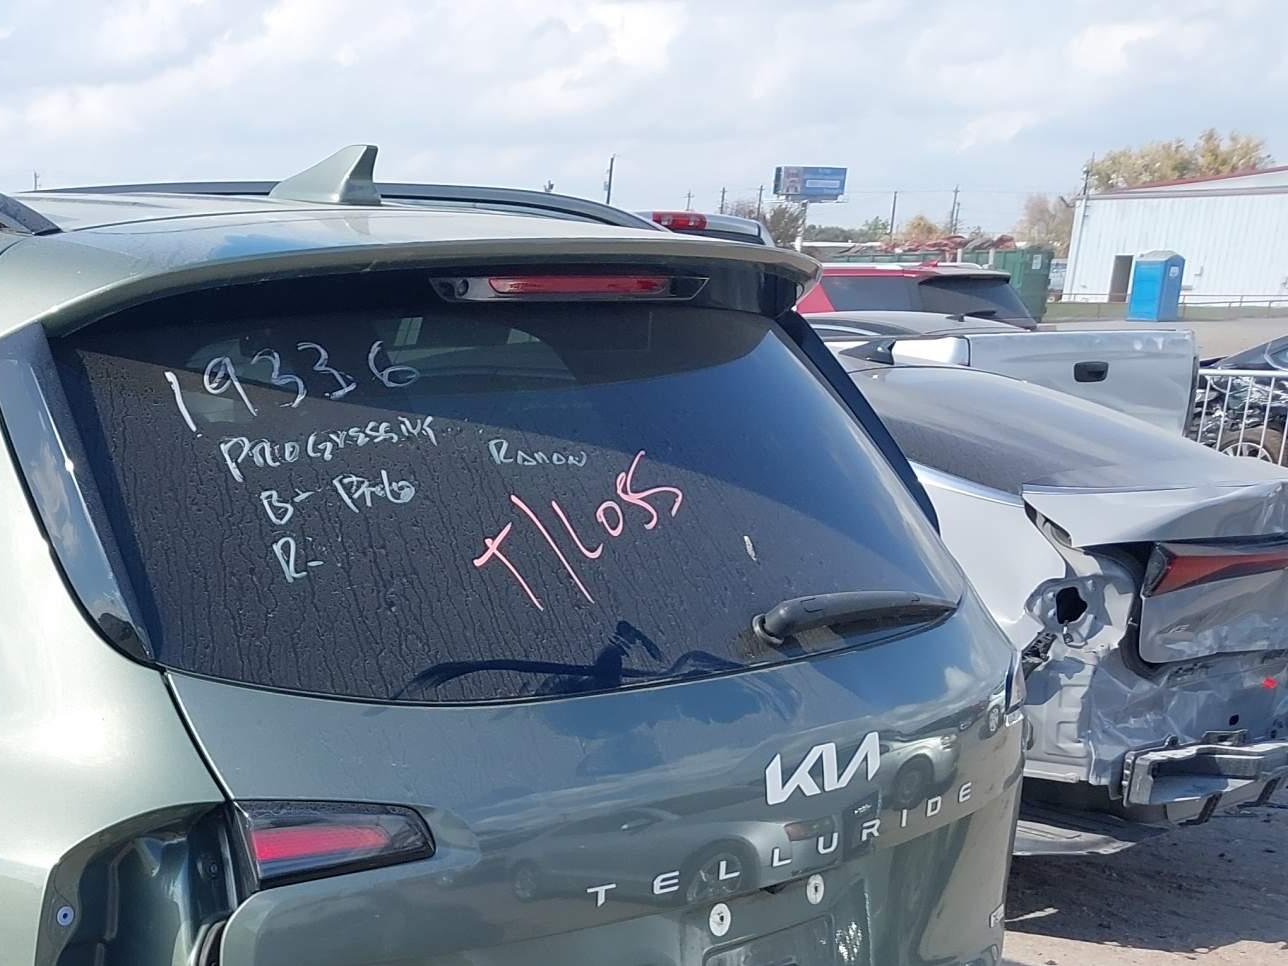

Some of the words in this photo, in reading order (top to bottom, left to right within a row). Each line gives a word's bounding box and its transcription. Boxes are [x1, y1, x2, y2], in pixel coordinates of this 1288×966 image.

[164, 340, 420, 438] 19336
[765, 731, 881, 806] KIA
[586, 781, 973, 908] TELLURIDE
